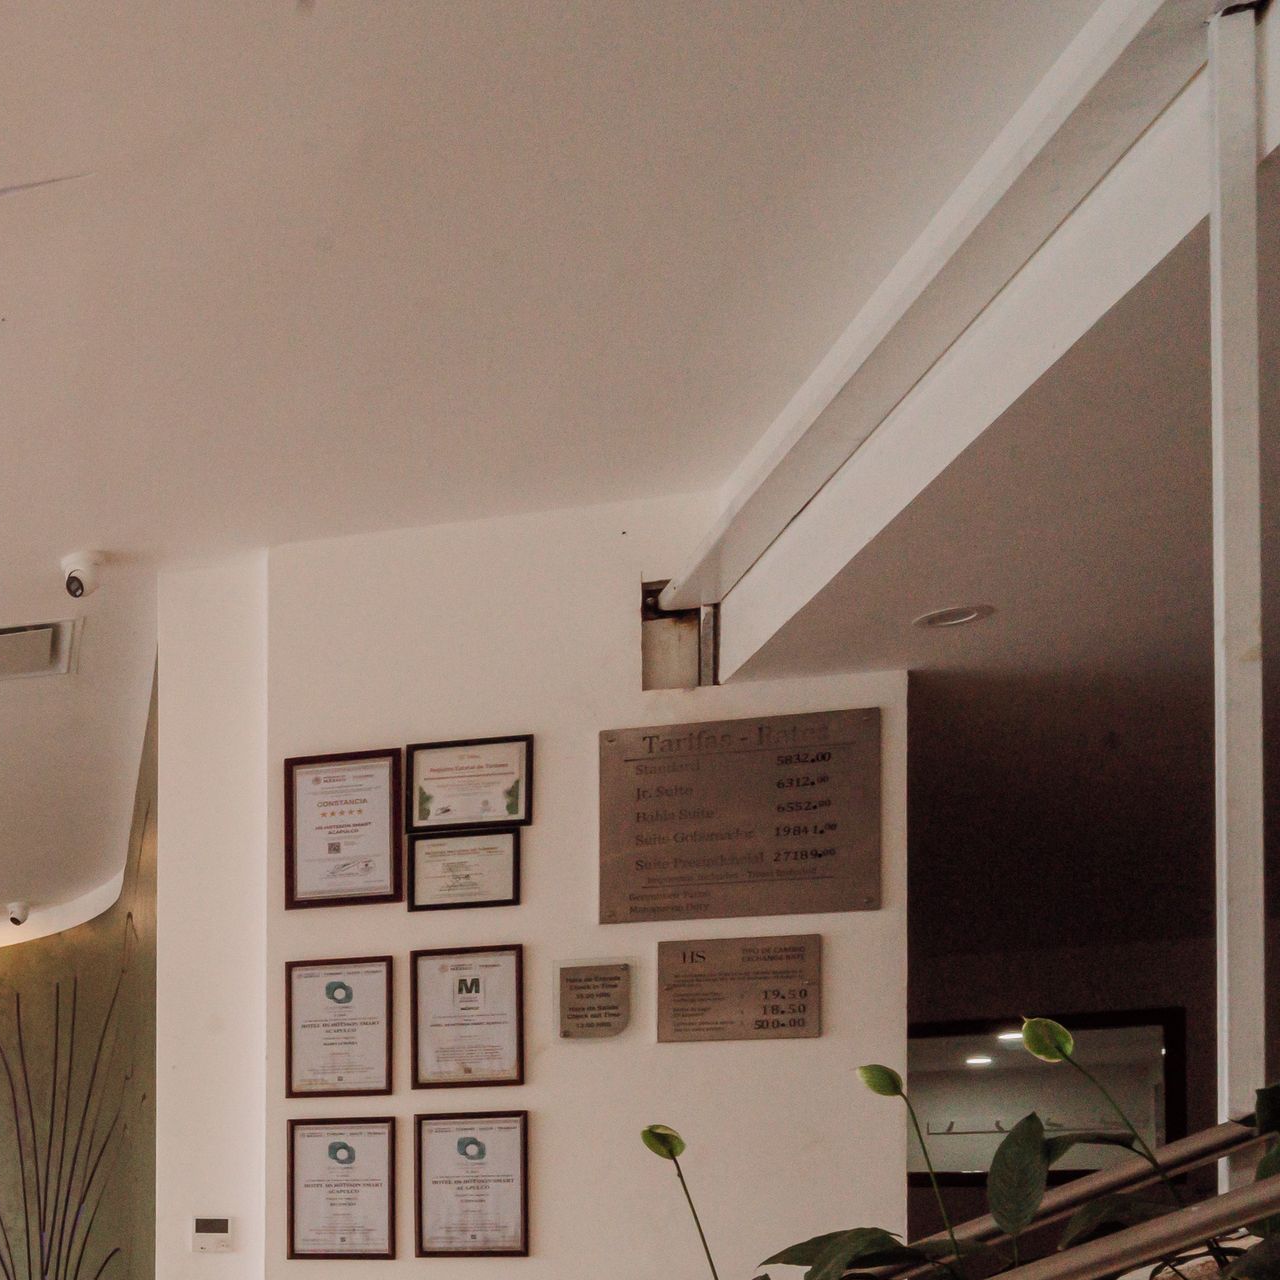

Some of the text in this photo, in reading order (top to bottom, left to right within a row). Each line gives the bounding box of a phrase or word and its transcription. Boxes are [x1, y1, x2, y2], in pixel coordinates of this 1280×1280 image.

[643, 728, 738, 754] Tarifas
[776, 751, 832, 767] 5832.00
[655, 784, 694, 798] Suite
[316, 798, 368, 808] CONSTANCIA
[677, 808, 716, 821] Suite
[635, 857, 669, 872] Suite
[458, 978, 480, 994] M
